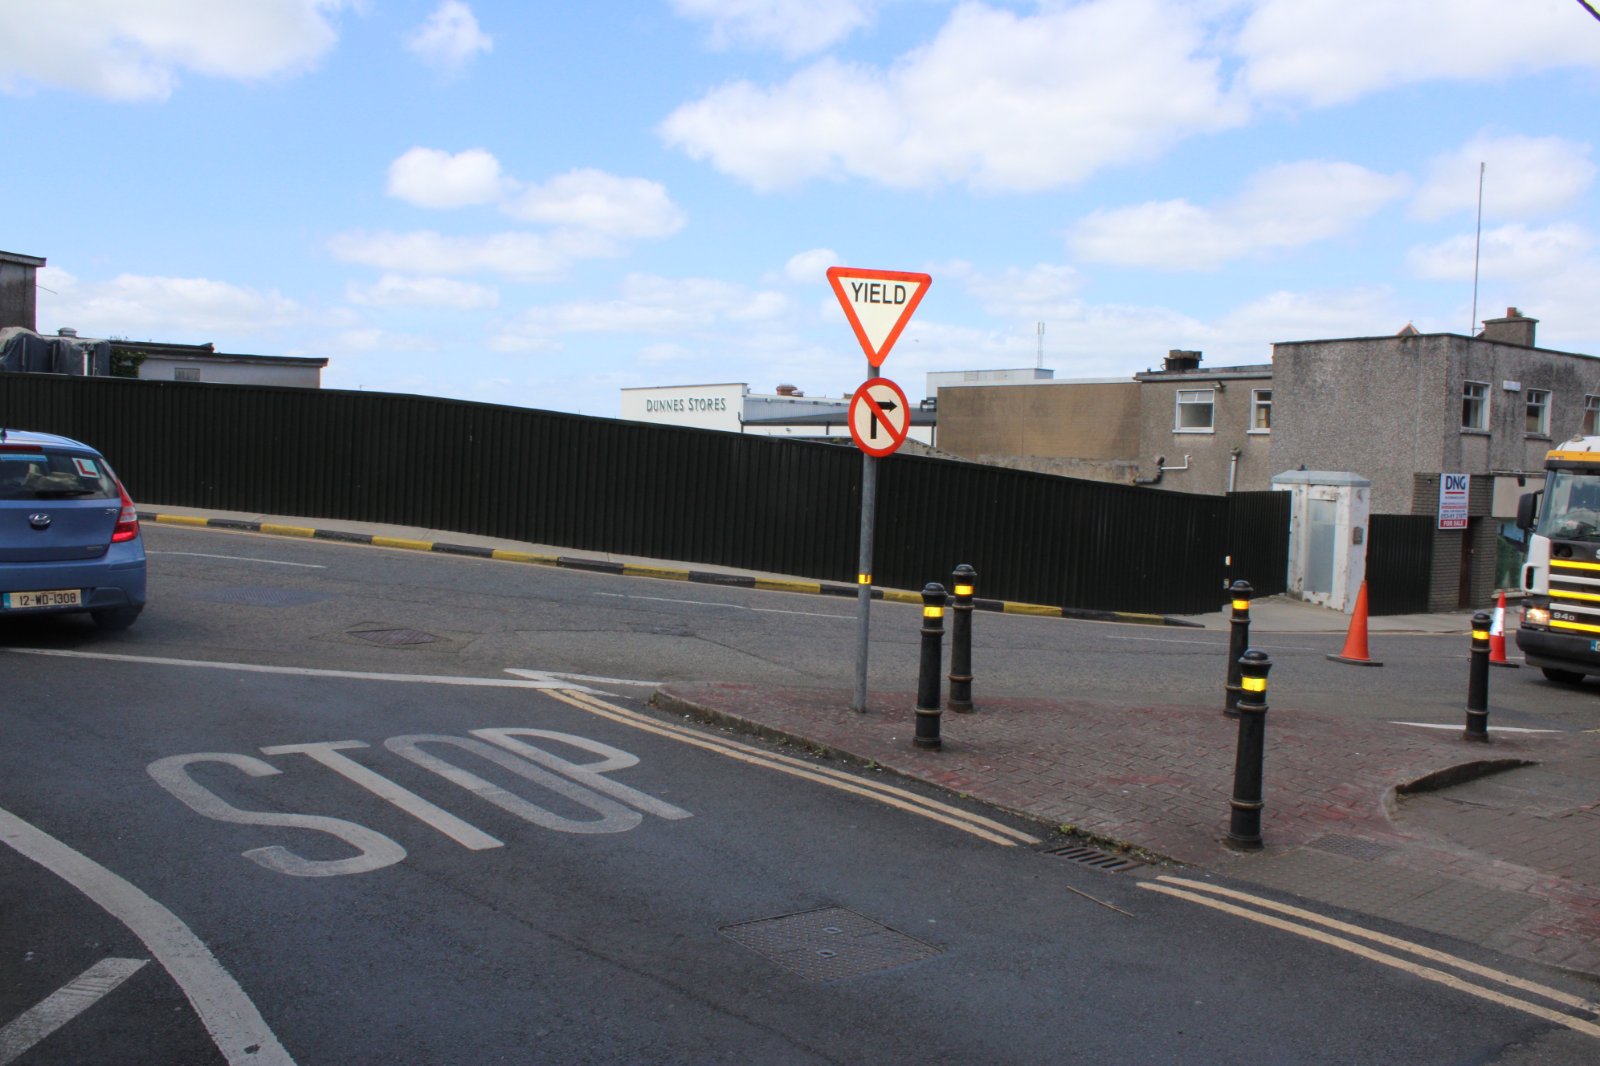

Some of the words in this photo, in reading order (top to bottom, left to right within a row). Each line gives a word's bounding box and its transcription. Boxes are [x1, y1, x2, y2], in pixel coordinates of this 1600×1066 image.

[851, 281, 907, 305] YIELD
[646, 399, 685, 412] DUNNES
[688, 397, 727, 411] STORES
[76, 459, 98, 476] L
[1445, 475, 1467, 490] DNG
[19, 592, 77, 606] 12-WD-1308
[146, 727, 694, 877] STOP
